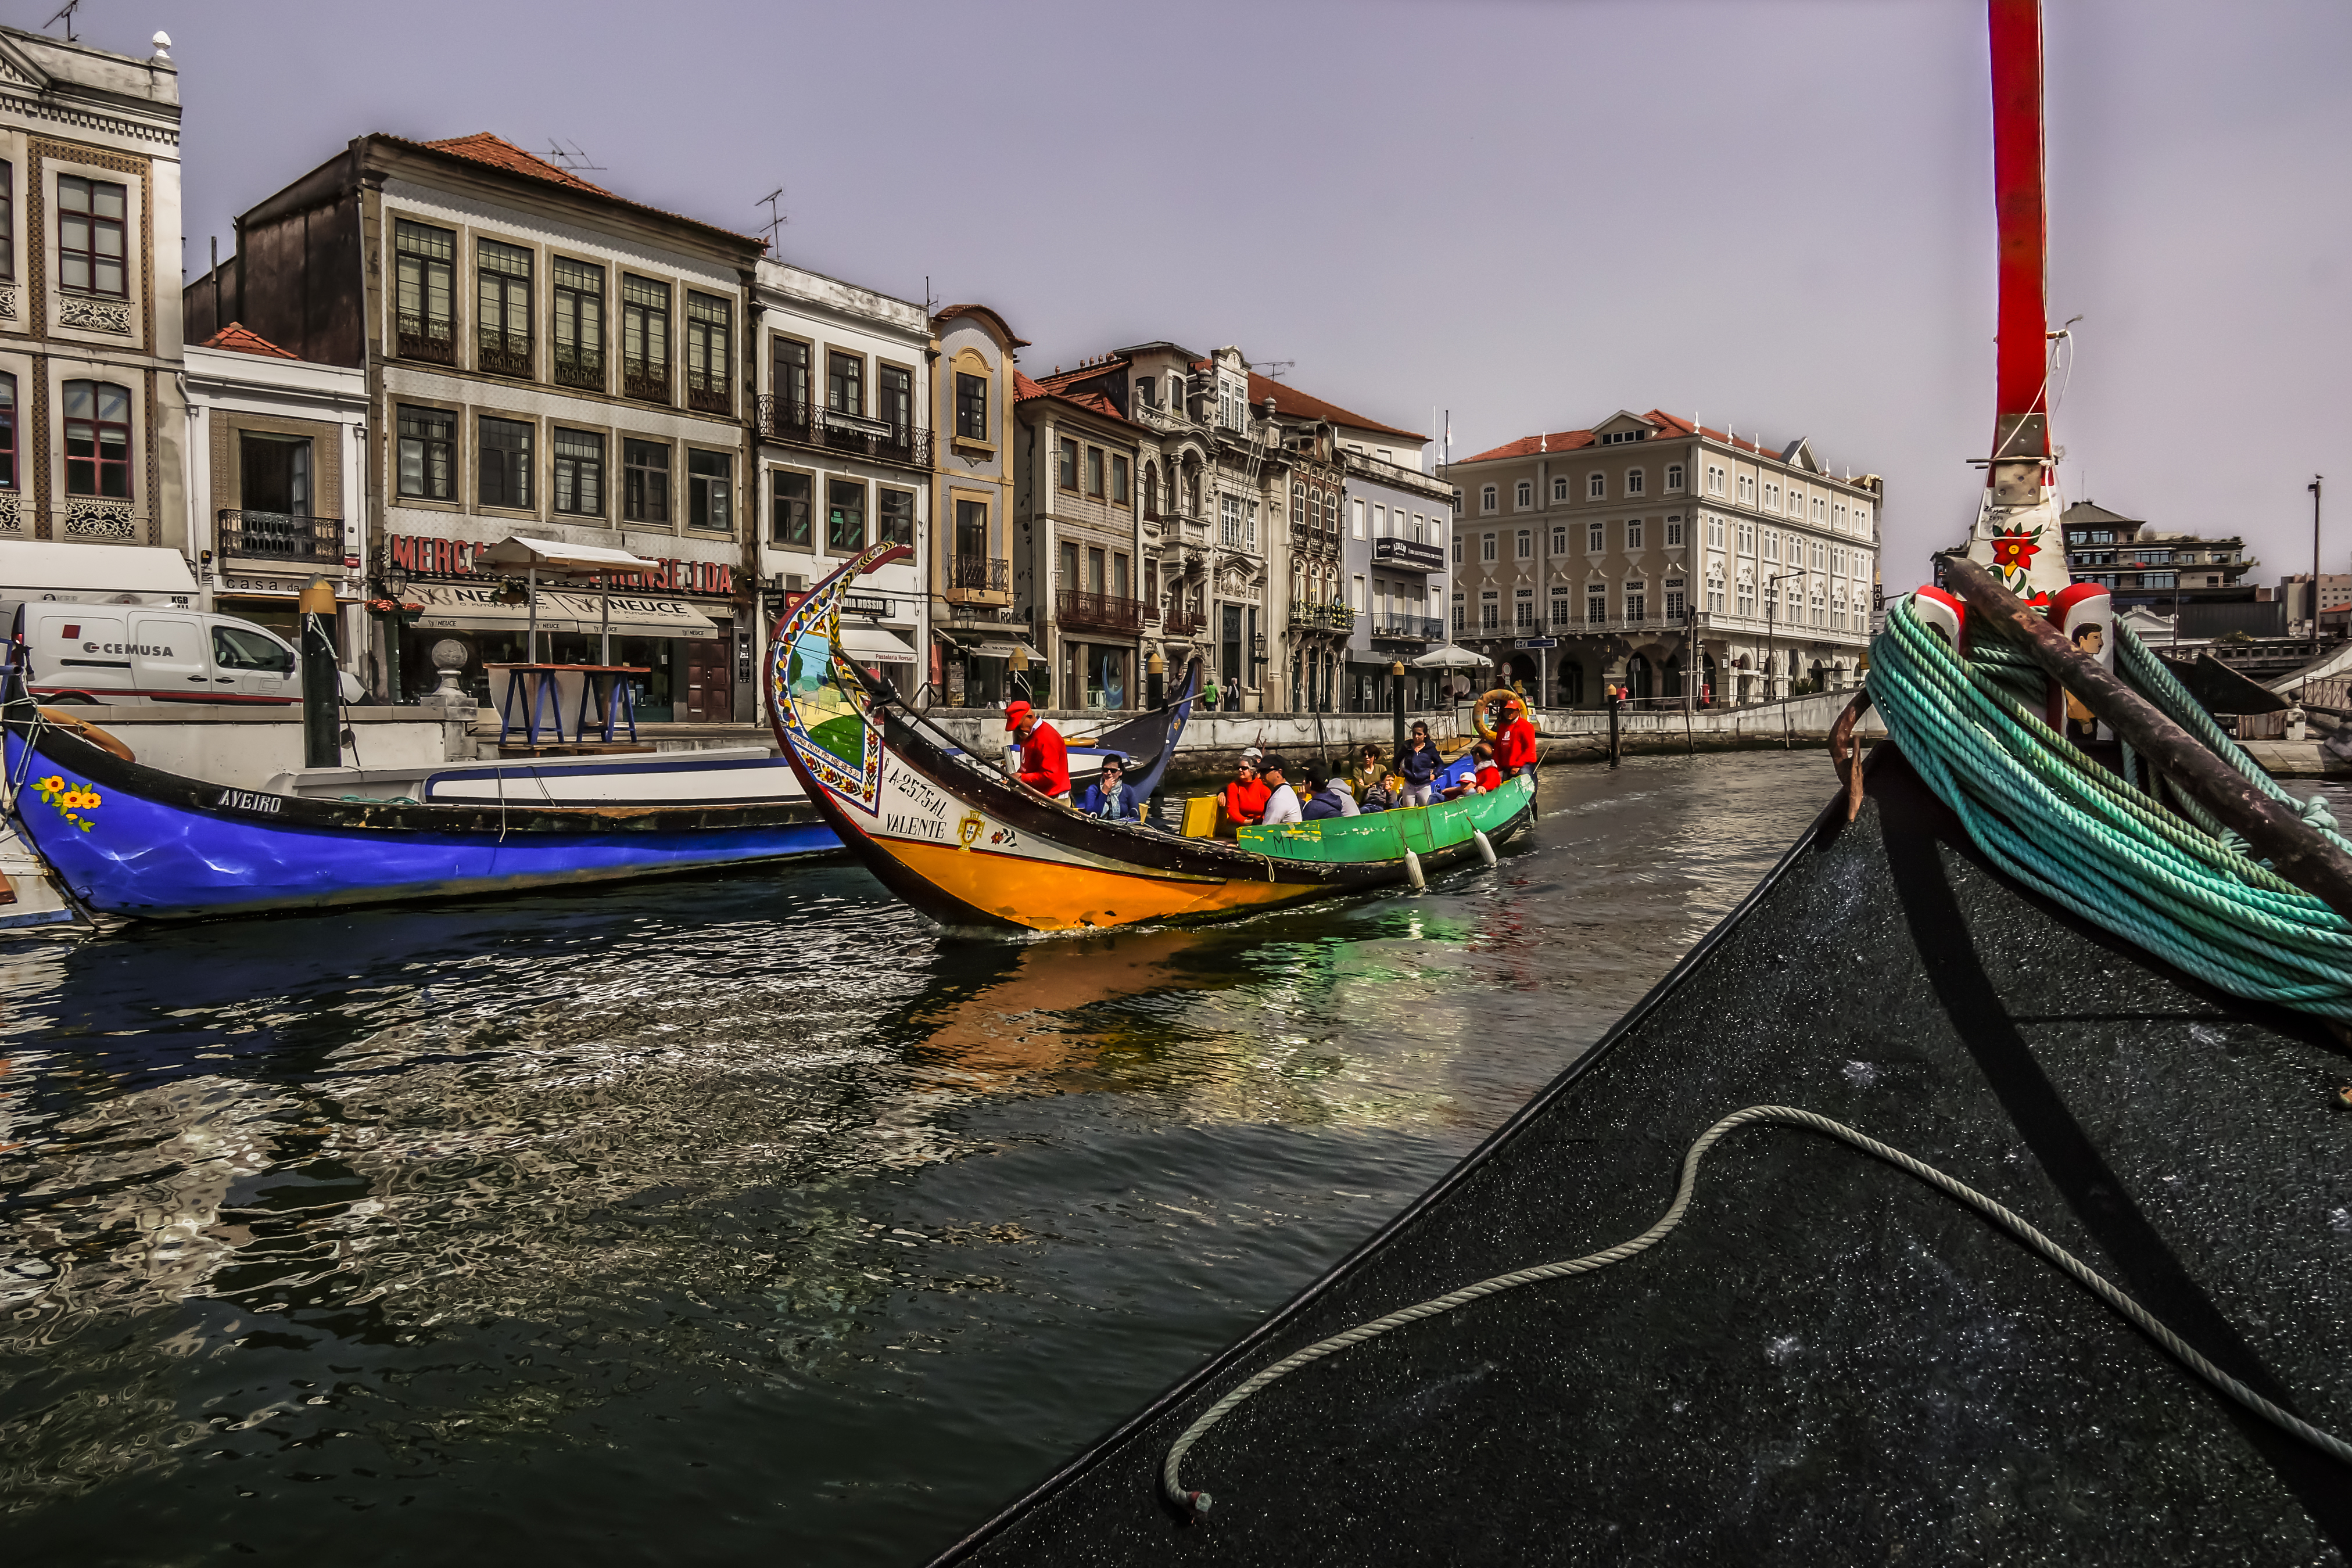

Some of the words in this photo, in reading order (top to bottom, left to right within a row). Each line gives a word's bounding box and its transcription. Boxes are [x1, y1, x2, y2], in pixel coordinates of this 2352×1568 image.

[226, 579, 278, 591] casa
[287, 583, 299, 592] da
[171, 595, 189, 604] KGB
[454, 589, 547, 605] NEE
[857, 598, 883, 610] ROSSIO
[608, 599, 688, 614] NEUCE
[103, 643, 174, 657] CEMUSA
[218, 789, 282, 813] AVEIRO
[887, 813, 947, 839] VALENTE
[1273, 835, 1294, 855] MT
